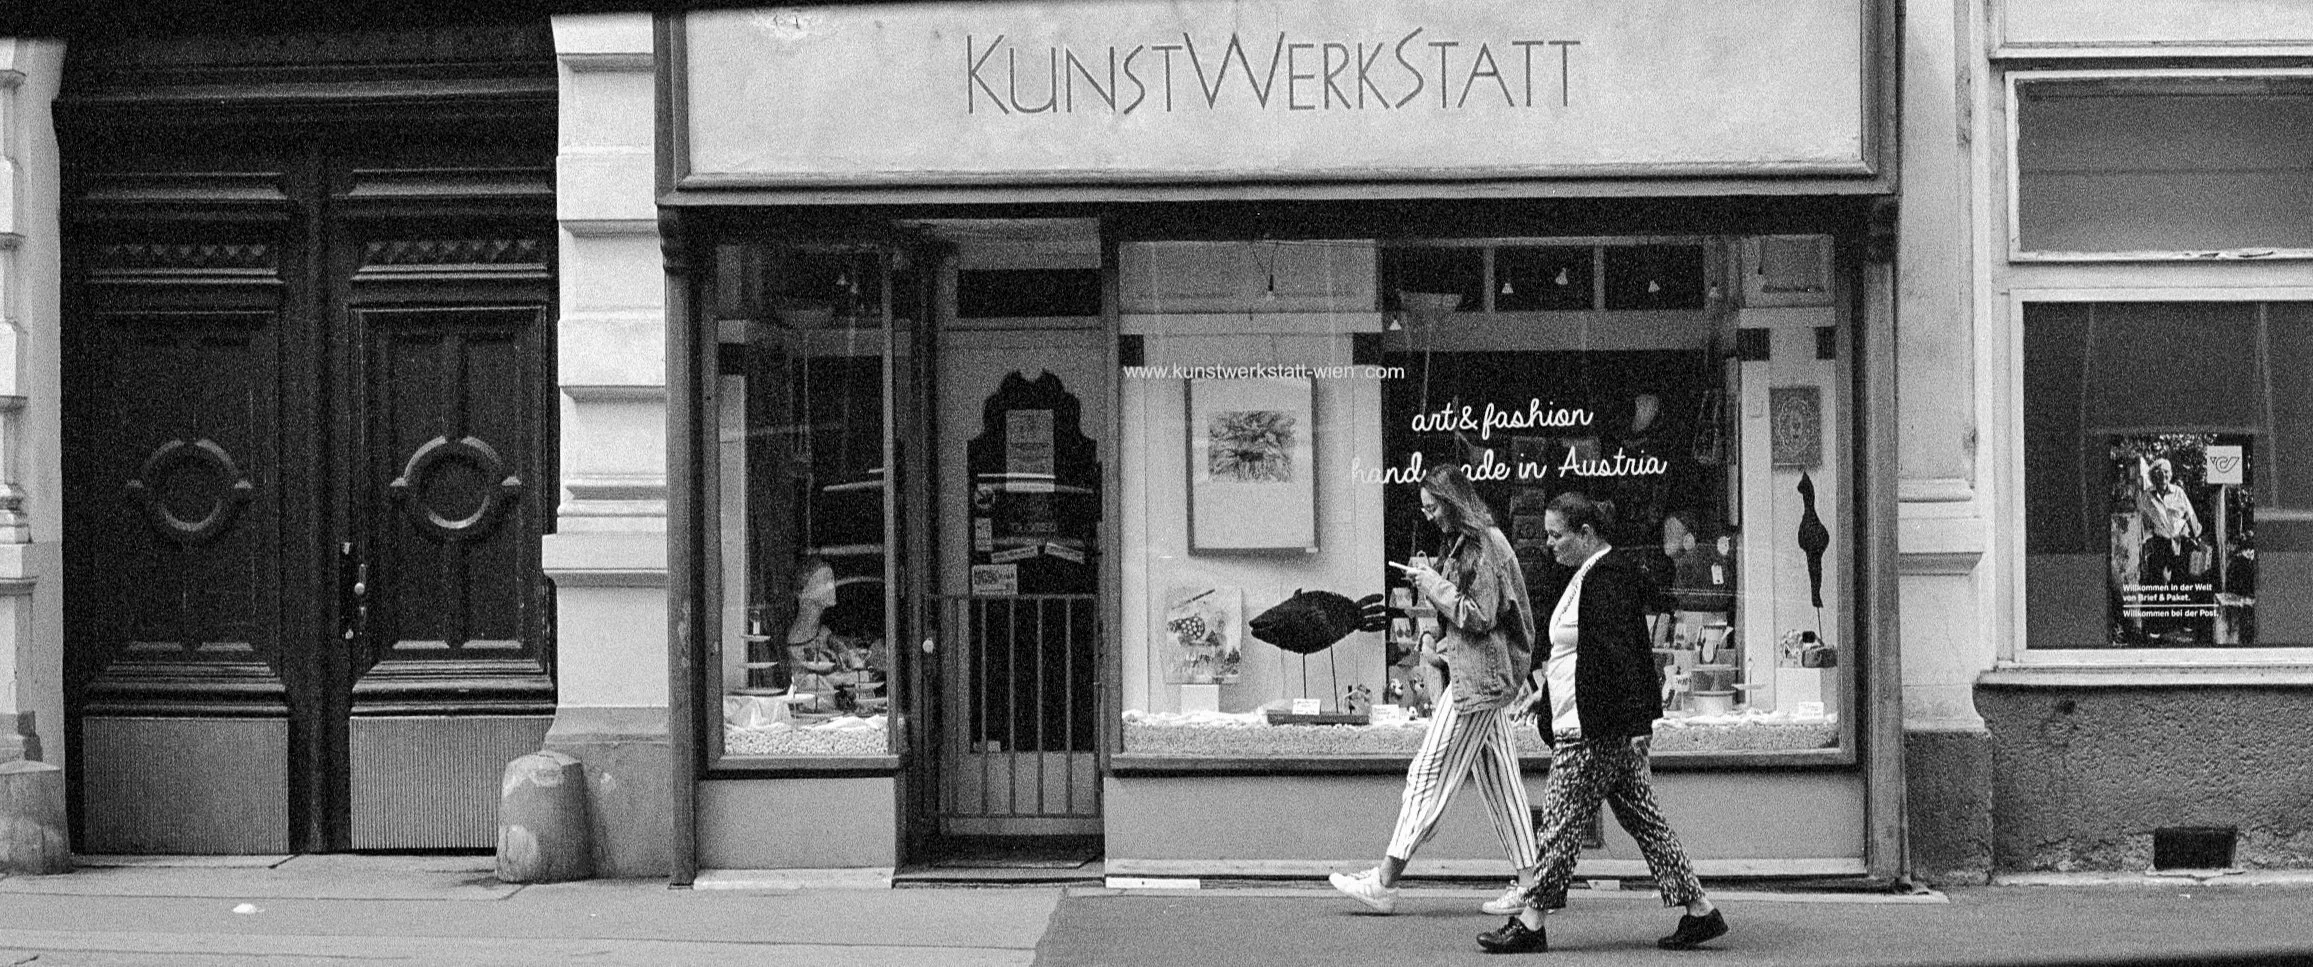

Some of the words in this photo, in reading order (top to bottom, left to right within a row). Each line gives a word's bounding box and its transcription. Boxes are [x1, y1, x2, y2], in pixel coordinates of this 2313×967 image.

[1460, 448, 1511, 481] ade
[1518, 453, 1547, 479] in
[1558, 445, 1668, 478] Austria
[2122, 583, 2169, 592] Willkommen
[2170, 583, 2179, 591] in
[2180, 583, 2194, 591] der
[2194, 583, 2213, 591] Welt
[2137, 593, 2158, 601] Brief
[2158, 593, 2165, 601] &
[2166, 593, 2191, 601] Paket.
[2122, 609, 2170, 618] Willkommen
[2171, 609, 2183, 617] bei
[2184, 609, 2199, 617] der
